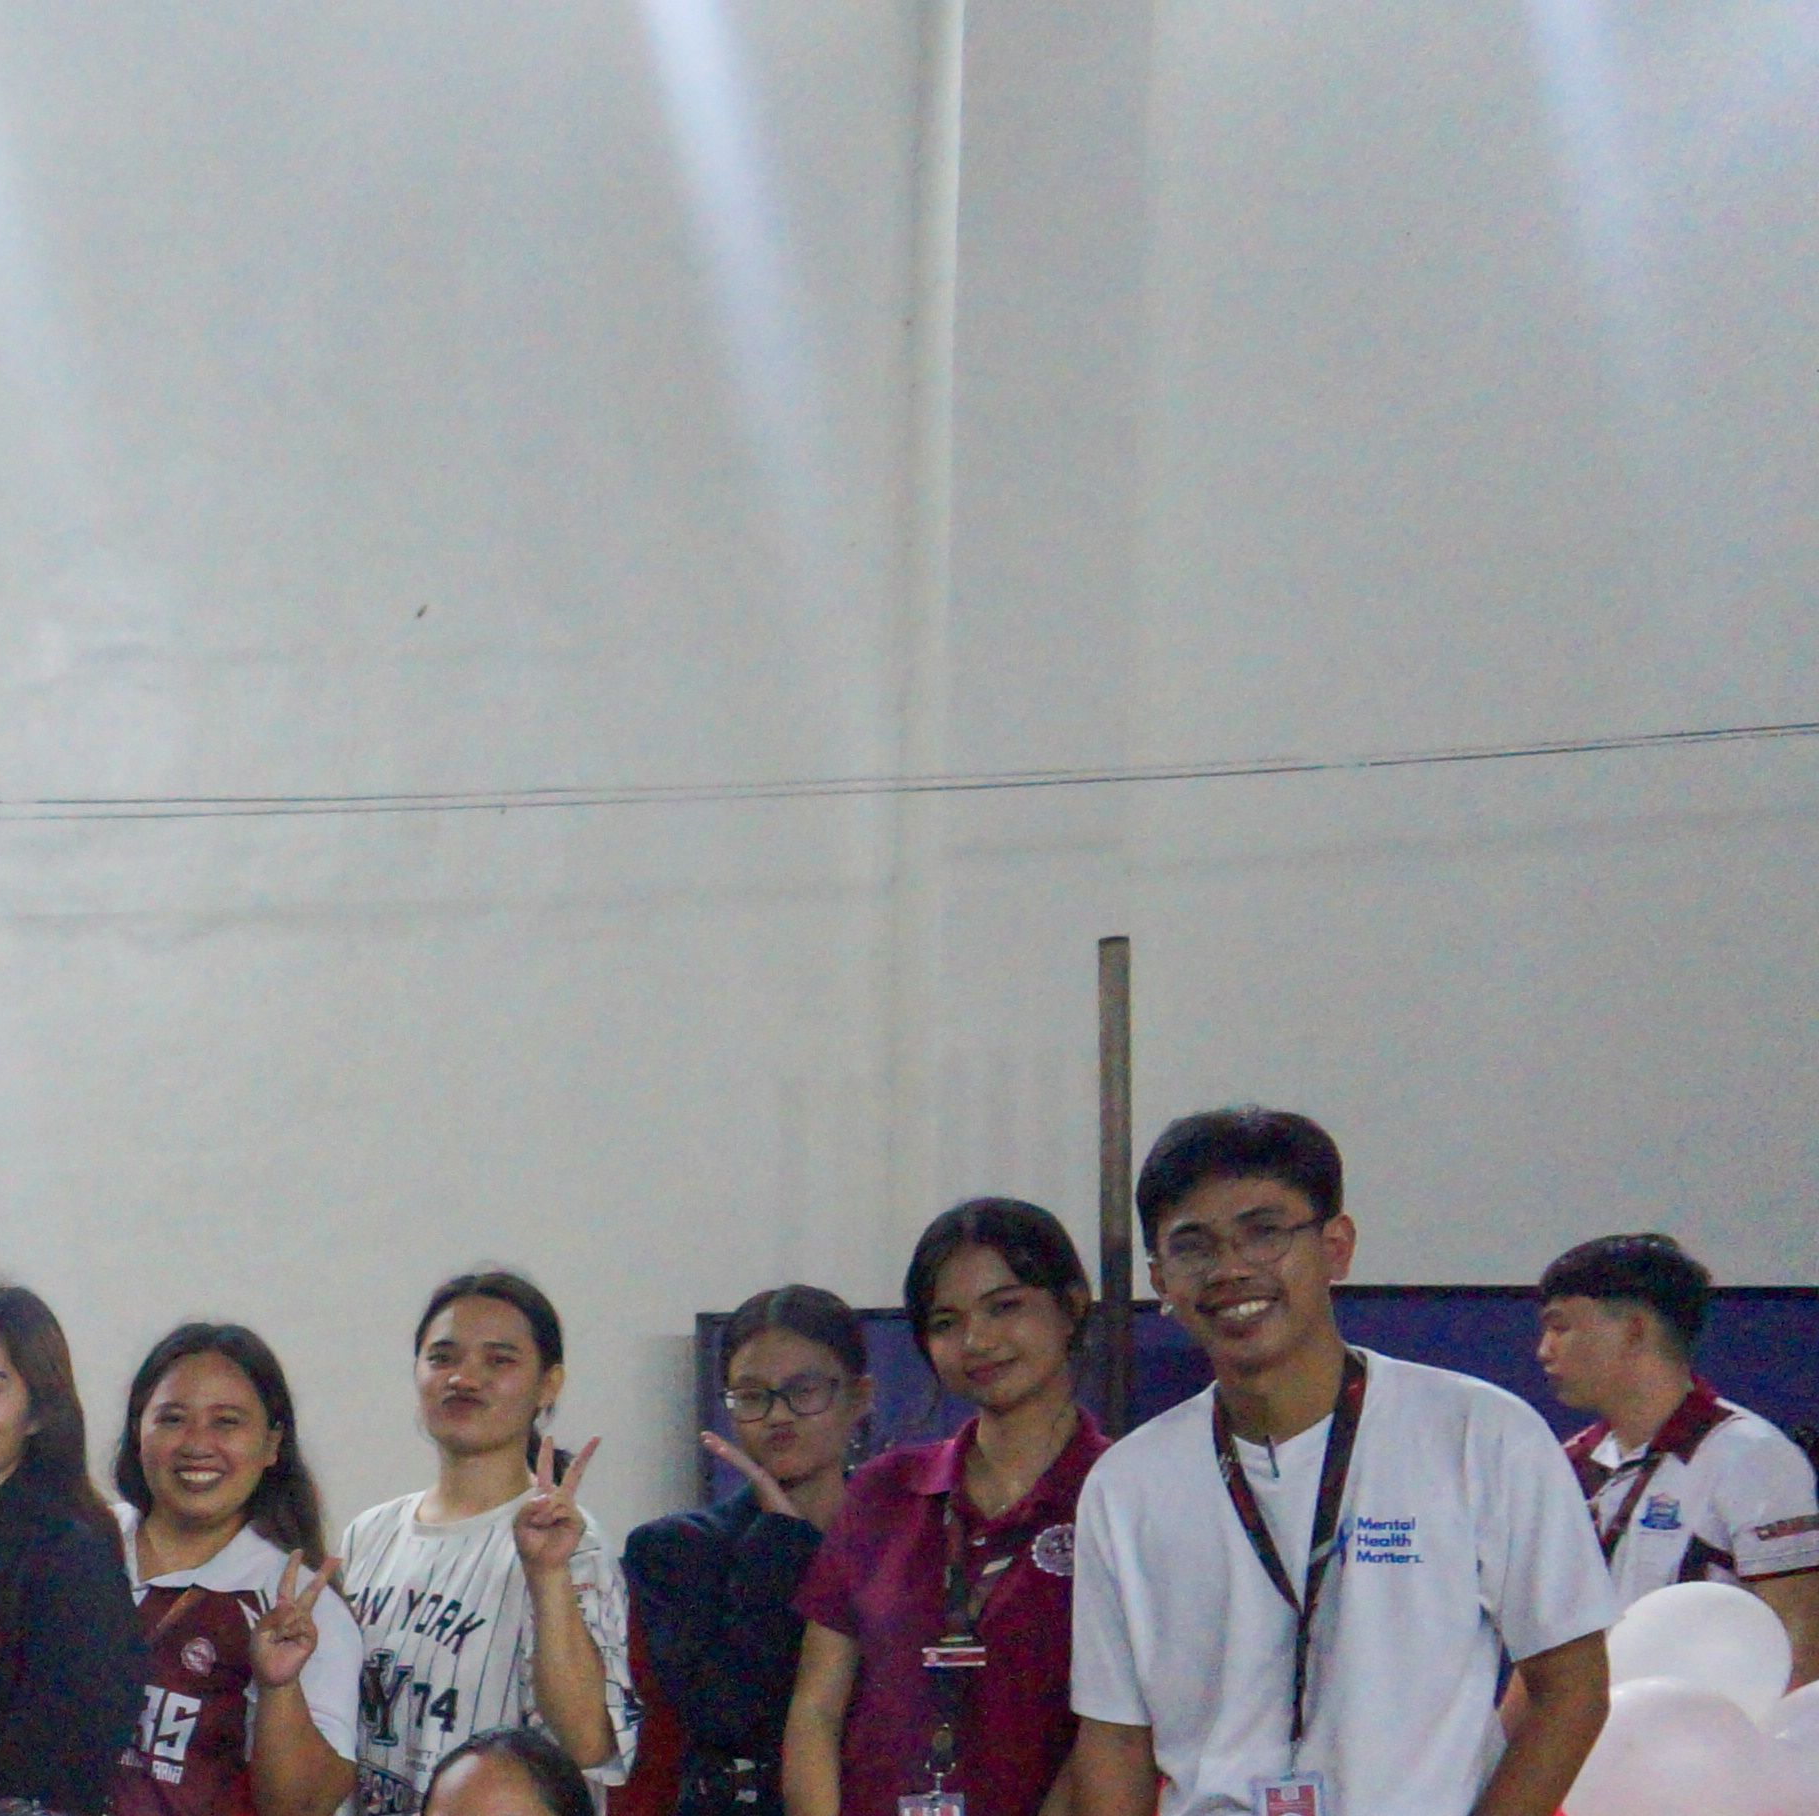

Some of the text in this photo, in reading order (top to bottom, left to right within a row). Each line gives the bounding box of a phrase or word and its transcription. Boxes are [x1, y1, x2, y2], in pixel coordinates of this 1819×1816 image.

[1356, 1516, 1416, 1531] Mental
[1356, 1532, 1413, 1548] Health
[399, 1588, 487, 1656] YORK
[413, 1682, 459, 1733] 74
